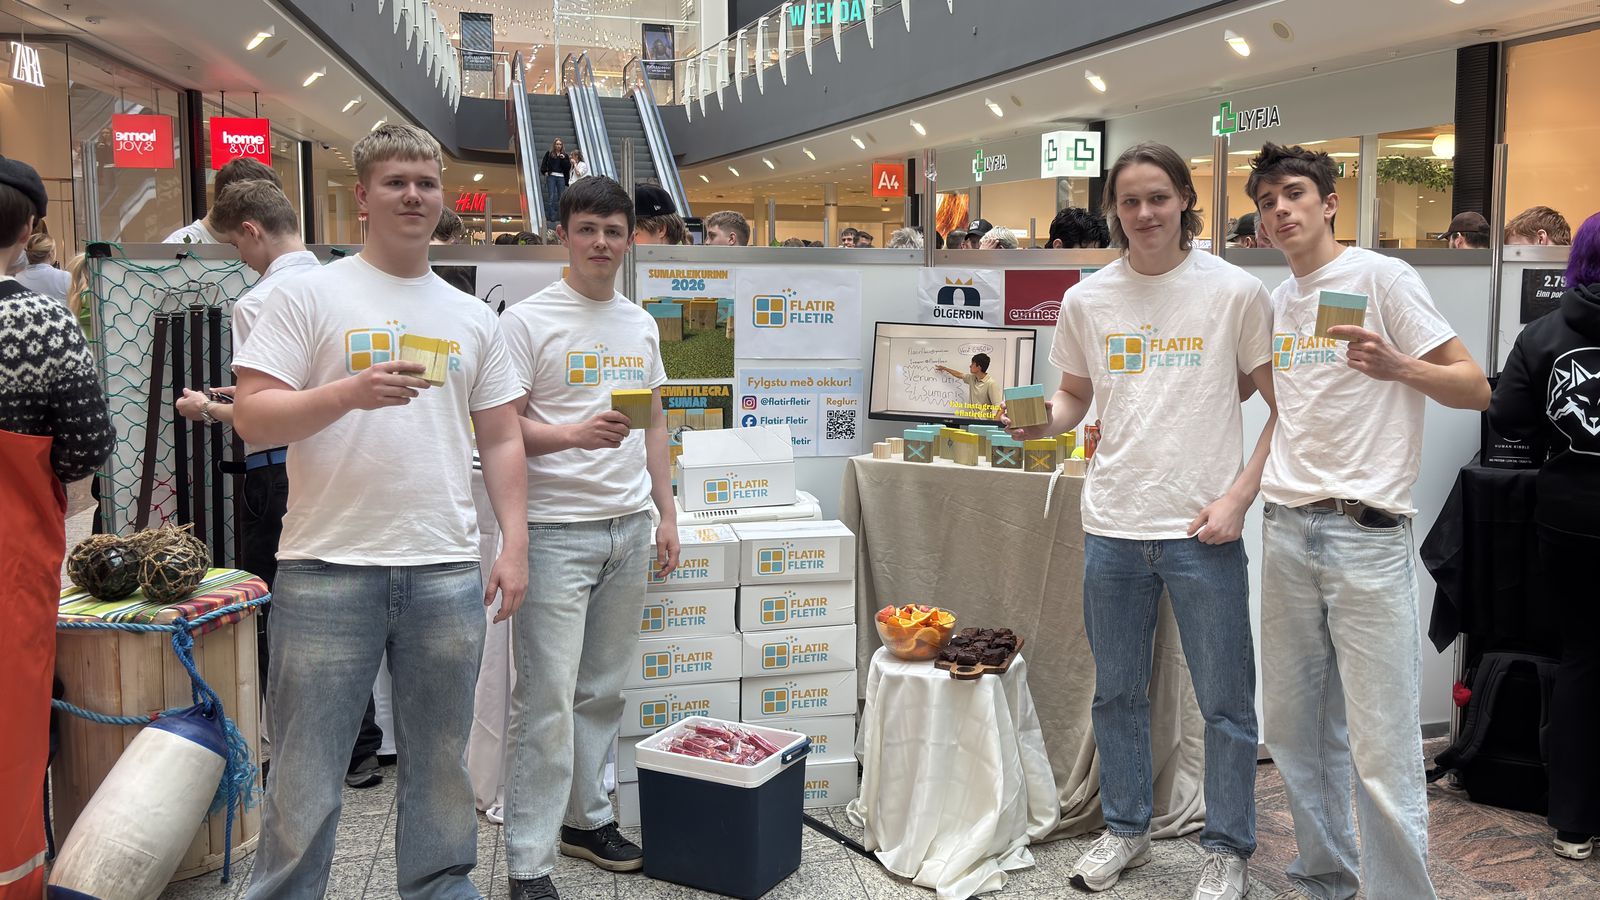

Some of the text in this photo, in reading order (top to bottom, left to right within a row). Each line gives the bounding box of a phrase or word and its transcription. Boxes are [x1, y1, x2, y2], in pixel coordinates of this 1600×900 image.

[11, 41, 45, 87] ZARA
[1238, 105, 1280, 132] LYFJA
[223, 131, 264, 144] home
[986, 154, 1008, 172] LYFJA
[878, 171, 900, 190] A4
[455, 192, 487, 213] H&M
[648, 269, 729, 280] SUMARLEIKURINN
[671, 279, 706, 291] 2026
[1544, 275, 1568, 288] 2.79
[790, 300, 835, 312] FLATIR
[790, 312, 834, 324] FLETIR
[933, 306, 984, 320] ÖLGERÐIN
[1150, 337, 1204, 353] FLATIR
[1296, 336, 1337, 350] FLATIR
[603, 356, 644, 368] FLATIR
[1149, 353, 1202, 368] FLETIR
[1294, 349, 1337, 364] FLETIR
[603, 368, 644, 381] FLETIR
[747, 376, 852, 389] Fylgstu með okkur!
[660, 385, 730, 397] EMMTILEGRA
[668, 396, 709, 408] SUMAR
[760, 397, 811, 406] @flatirfletir
[826, 397, 857, 407] Reglur:
[760, 416, 808, 425] Flatir Fletir
[733, 479, 769, 490] FLATIR
[733, 489, 768, 499] FLETIR
[788, 549, 825, 560] FLATIR
[676, 558, 709, 569] LATIR
[788, 560, 824, 570] FLETIR
[669, 569, 708, 580] FLETIR
[790, 597, 828, 609] FLATIR
[667, 606, 707, 617] FLATIR
[790, 607, 826, 619] FLETIR
[667, 616, 706, 627] FLETIR
[792, 642, 829, 654] FLATIR
[674, 651, 713, 663] FLATIR
[792, 653, 828, 664] FLETIR
[674, 662, 712, 673] FLETIR
[791, 688, 829, 699] FLATIR
[671, 700, 710, 712] FLATIR
[791, 698, 828, 709] FLETIR
[808, 735, 828, 744] TIR
[805, 780, 829, 790] ATIR
[804, 790, 828, 800] ETIR
